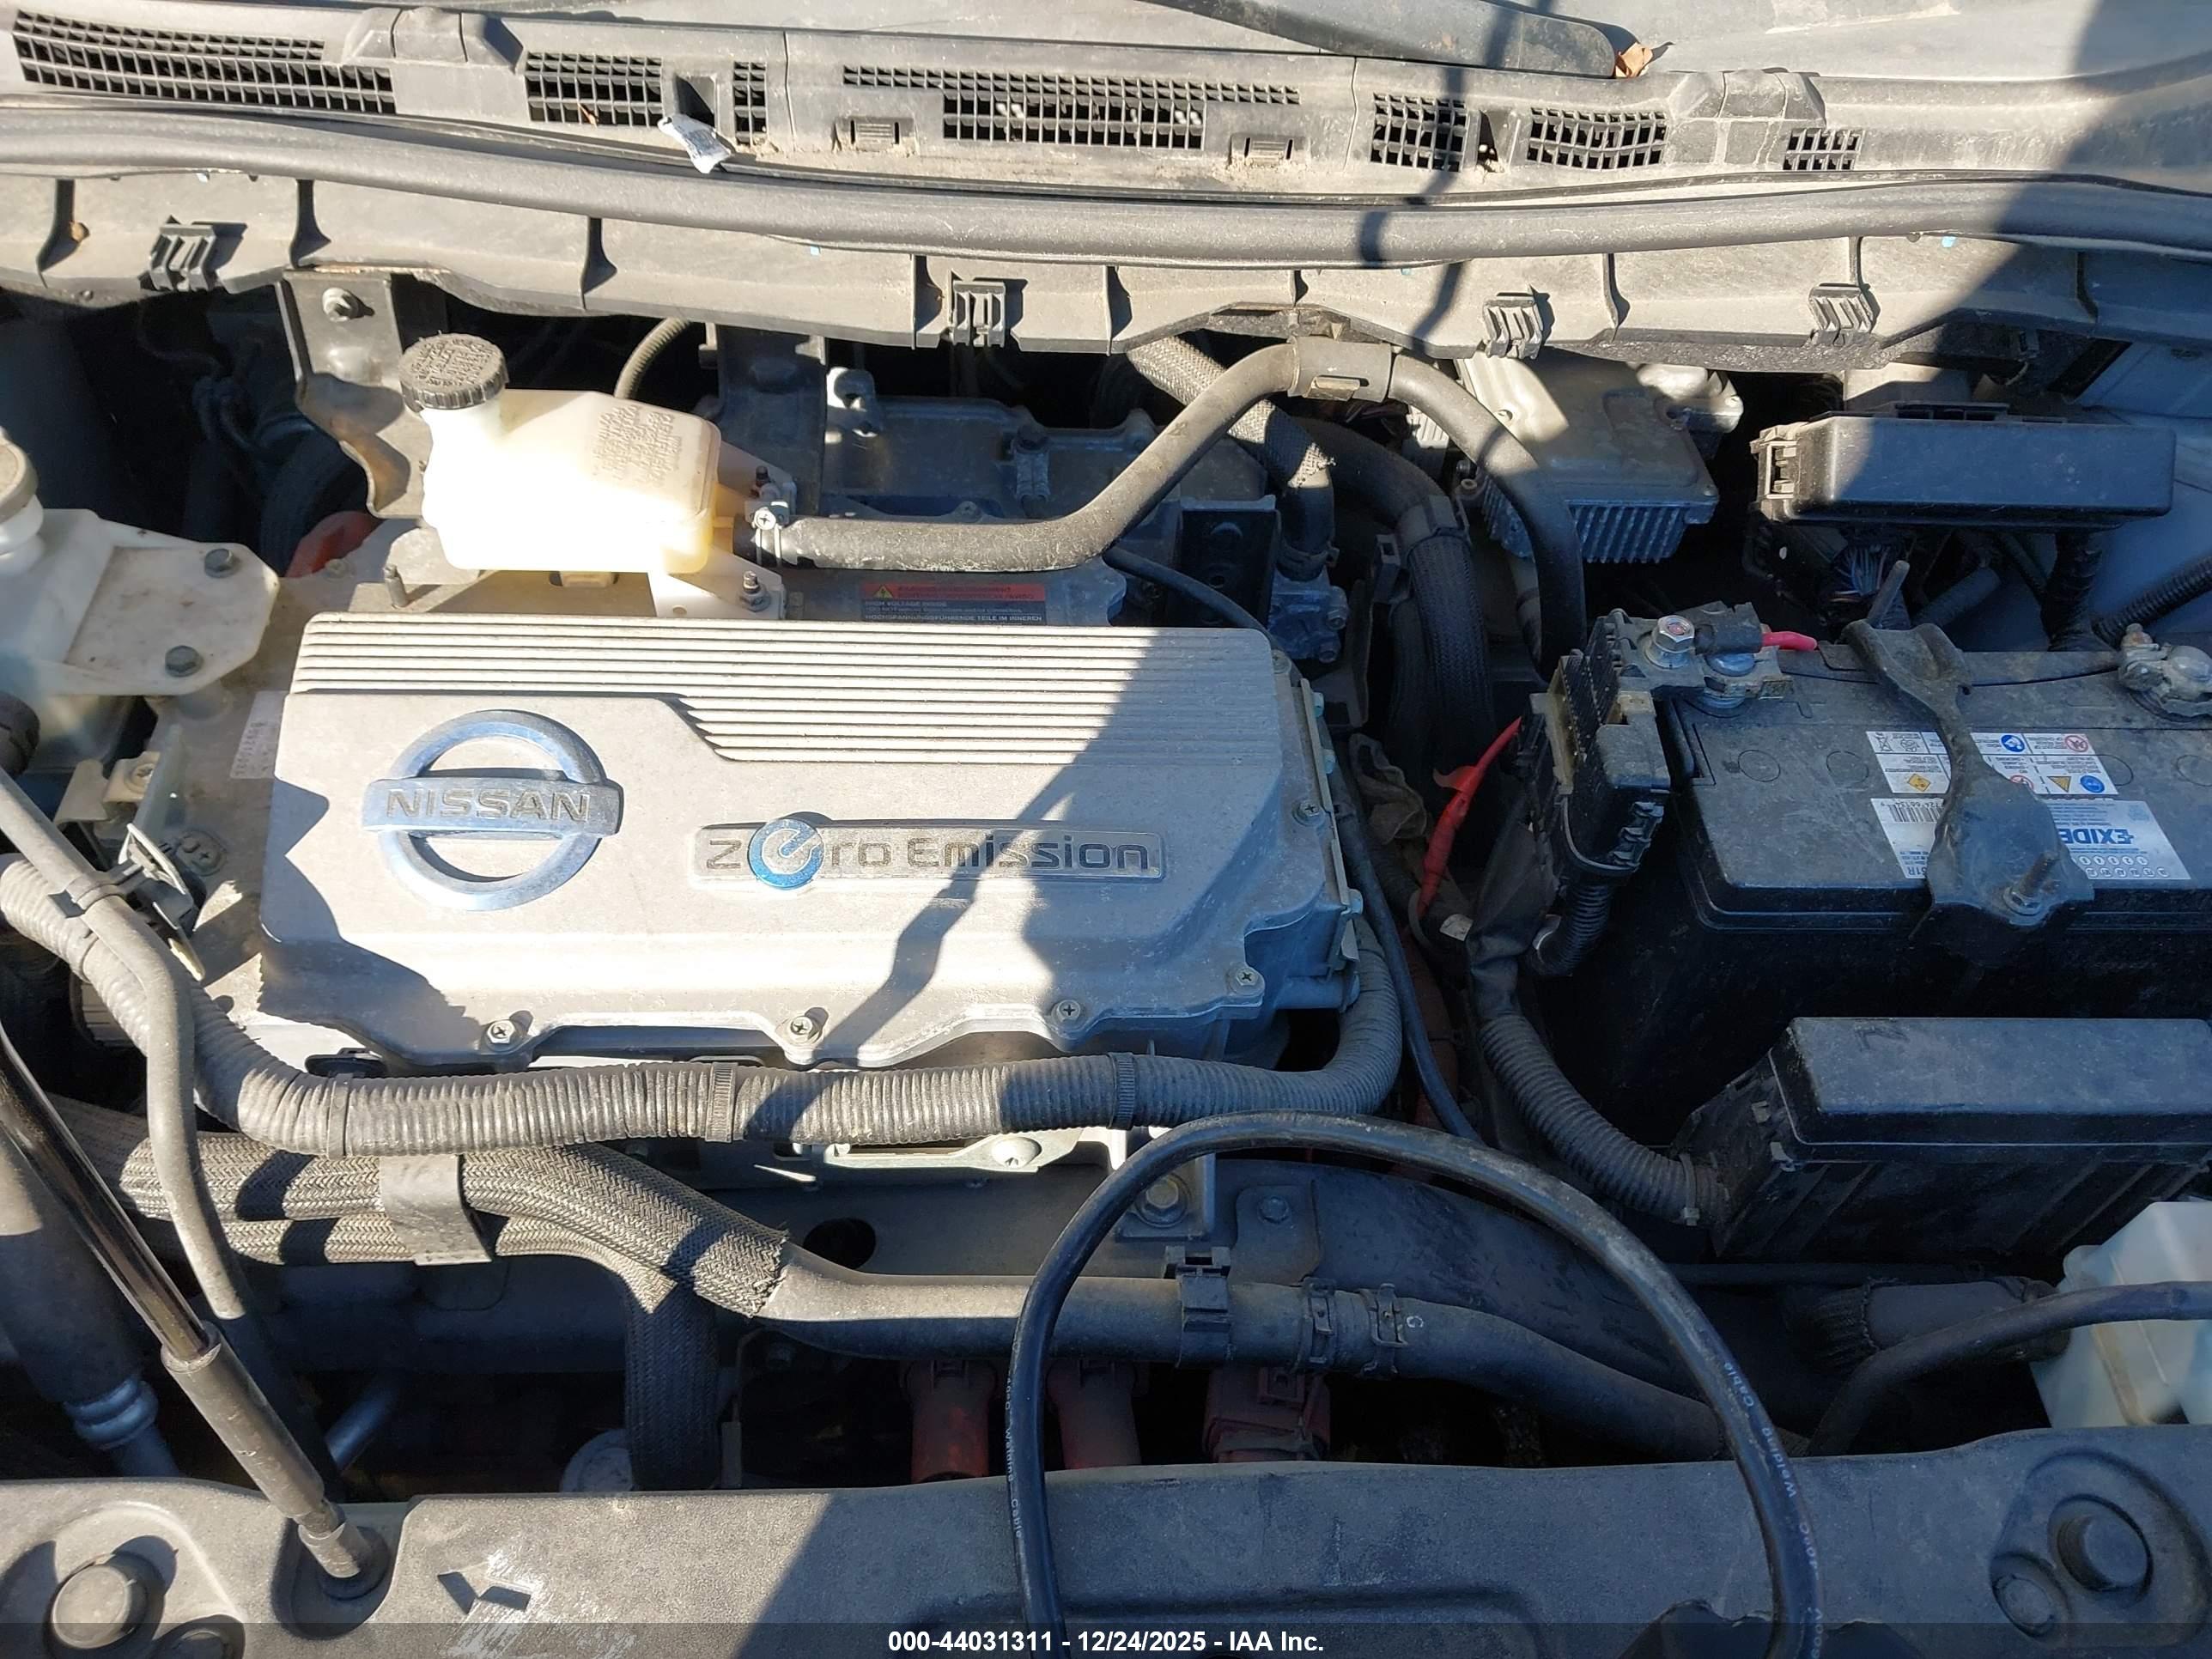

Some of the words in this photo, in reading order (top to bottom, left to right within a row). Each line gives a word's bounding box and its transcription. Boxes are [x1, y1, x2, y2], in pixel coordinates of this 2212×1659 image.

[386, 787, 591, 823] NISSAN
[908, 835, 1149, 870] Emission
[2057, 828, 2134, 844] EXIDE
[1723, 1361, 1754, 1407] Cable
[1761, 1426, 1797, 1498] Welding
[1011, 1498, 1023, 1539] Cable
